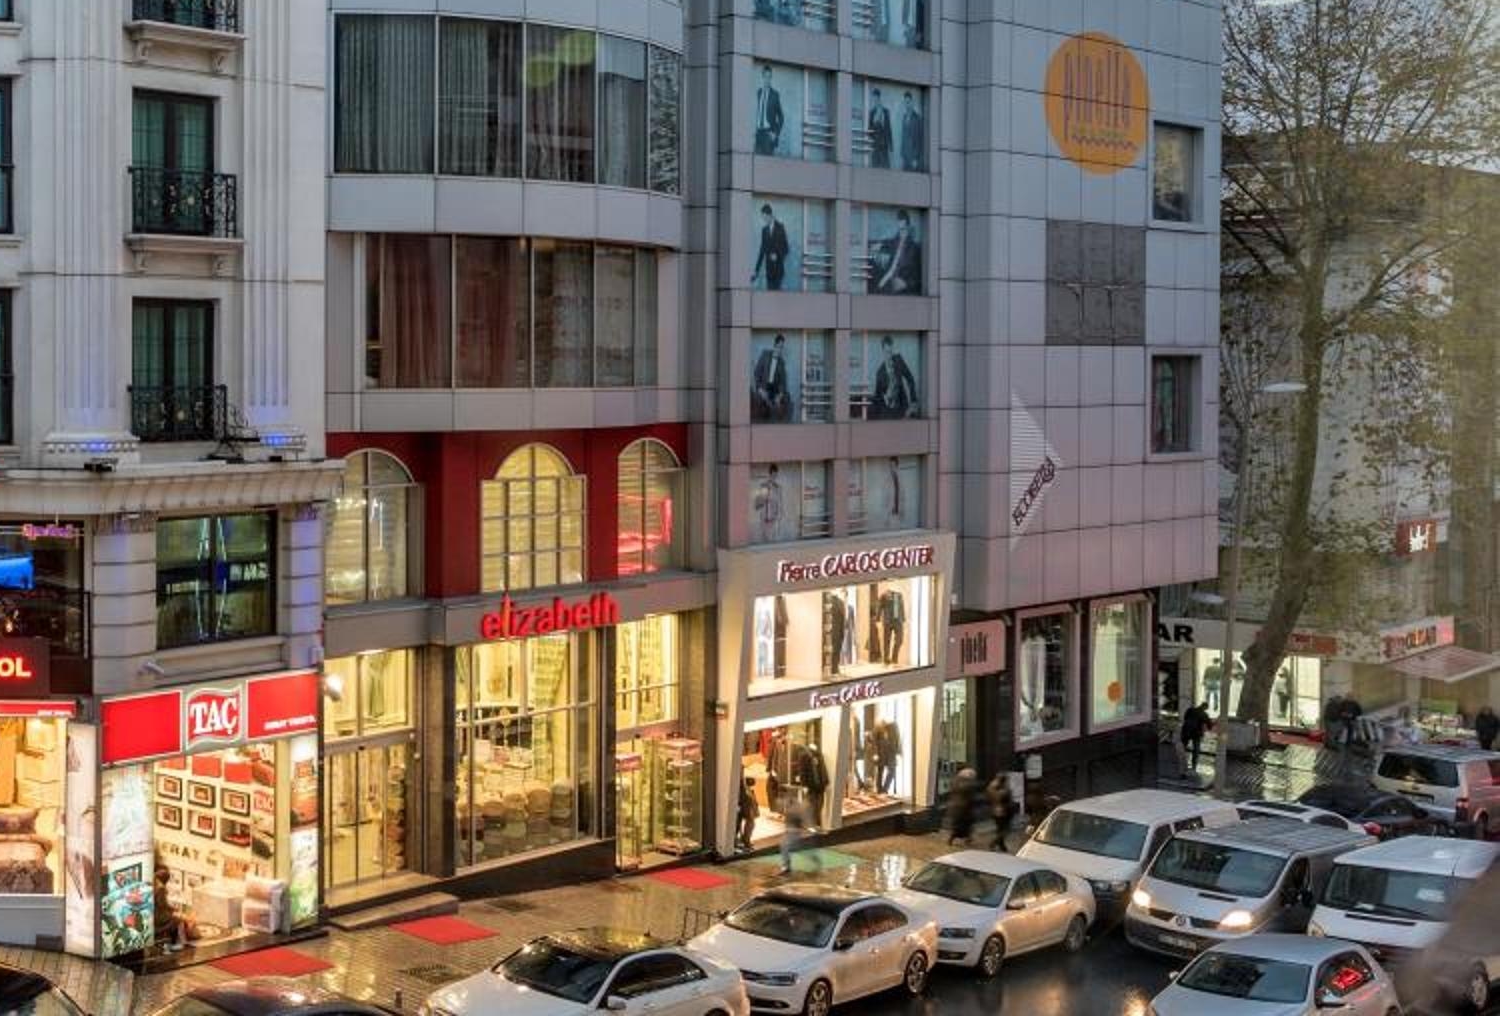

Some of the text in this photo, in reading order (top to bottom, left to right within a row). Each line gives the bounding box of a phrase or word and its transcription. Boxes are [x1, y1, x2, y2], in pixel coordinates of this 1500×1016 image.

[778, 544, 934, 582] Pierre CARLOS CENTER
[481, 592, 619, 640] elizabeth
[190, 697, 238, 735] TAÇ
